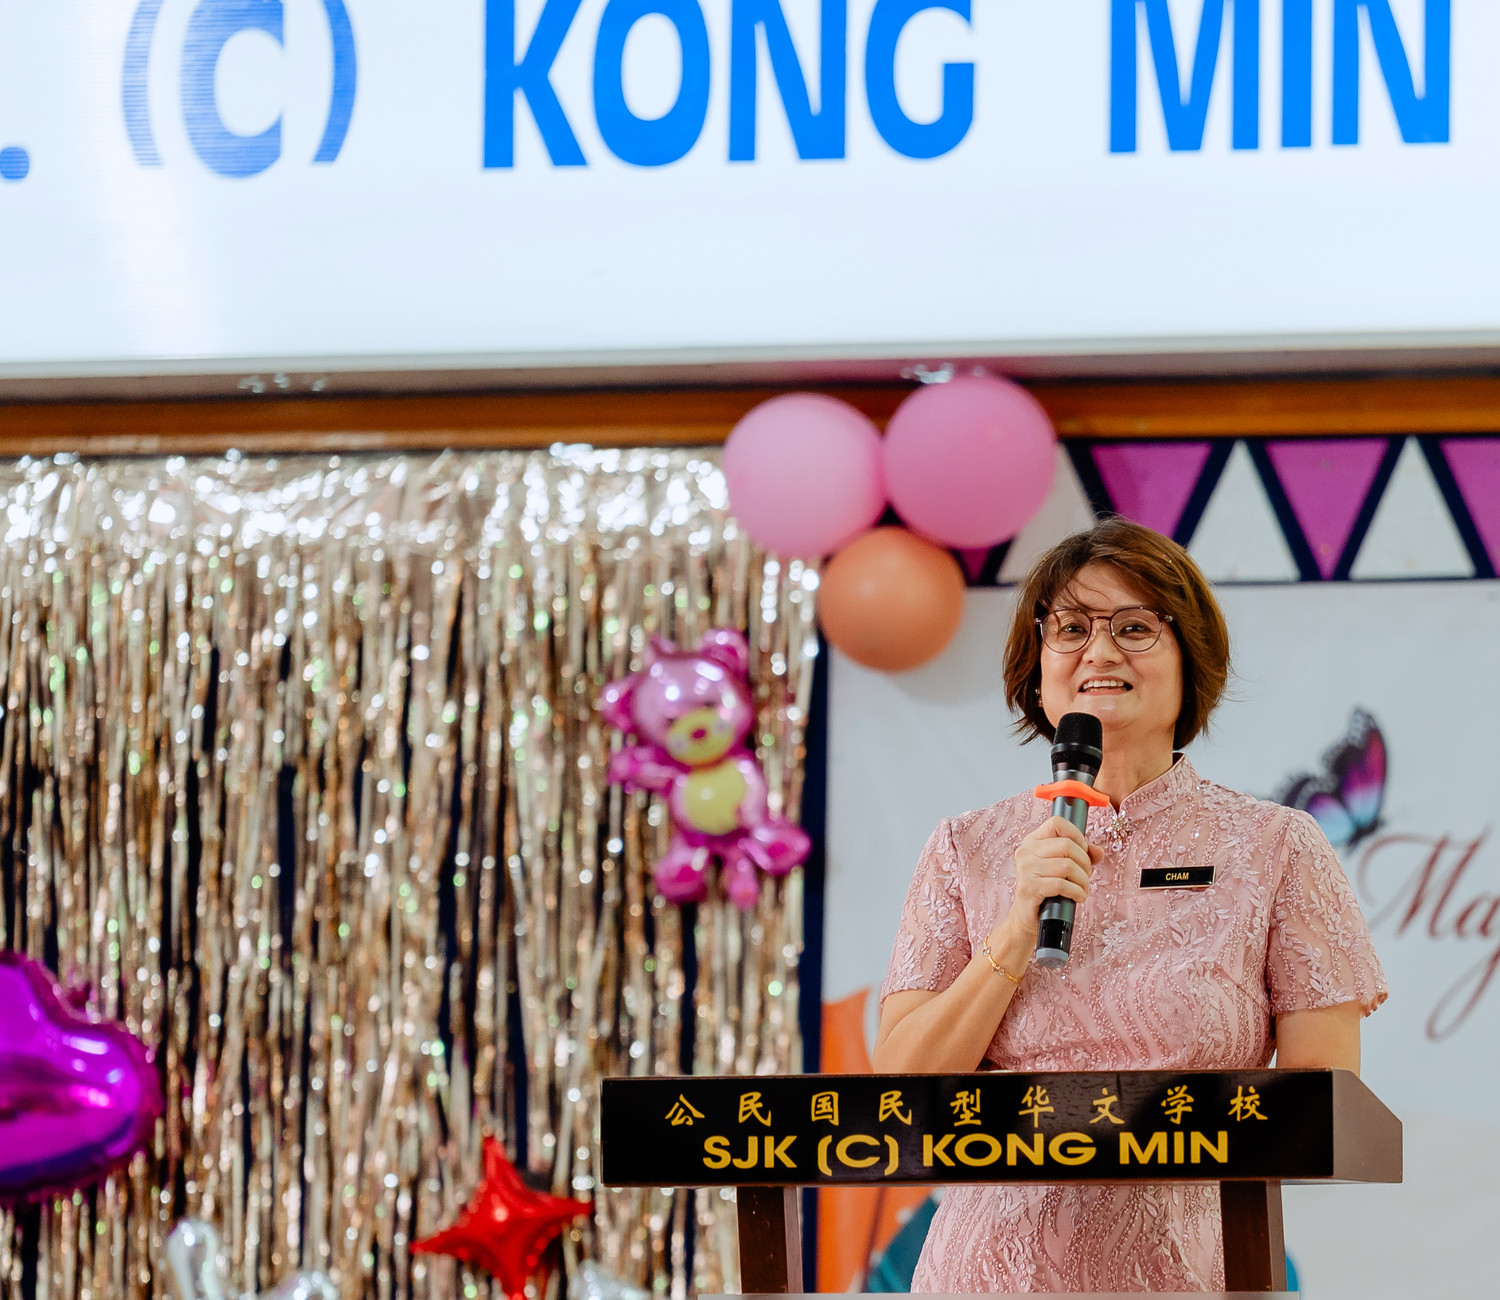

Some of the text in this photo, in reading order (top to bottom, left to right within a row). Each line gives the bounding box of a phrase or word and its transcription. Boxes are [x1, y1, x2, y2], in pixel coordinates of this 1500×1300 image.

[481, 0, 975, 168] KONG
[1108, 0, 1451, 153] MIN
[1165, 872, 1190, 881] CHAM
[664, 1085, 1269, 1129] 公民国民型华文学校
[702, 1130, 1230, 1178] SJK (C) KONG MIN
